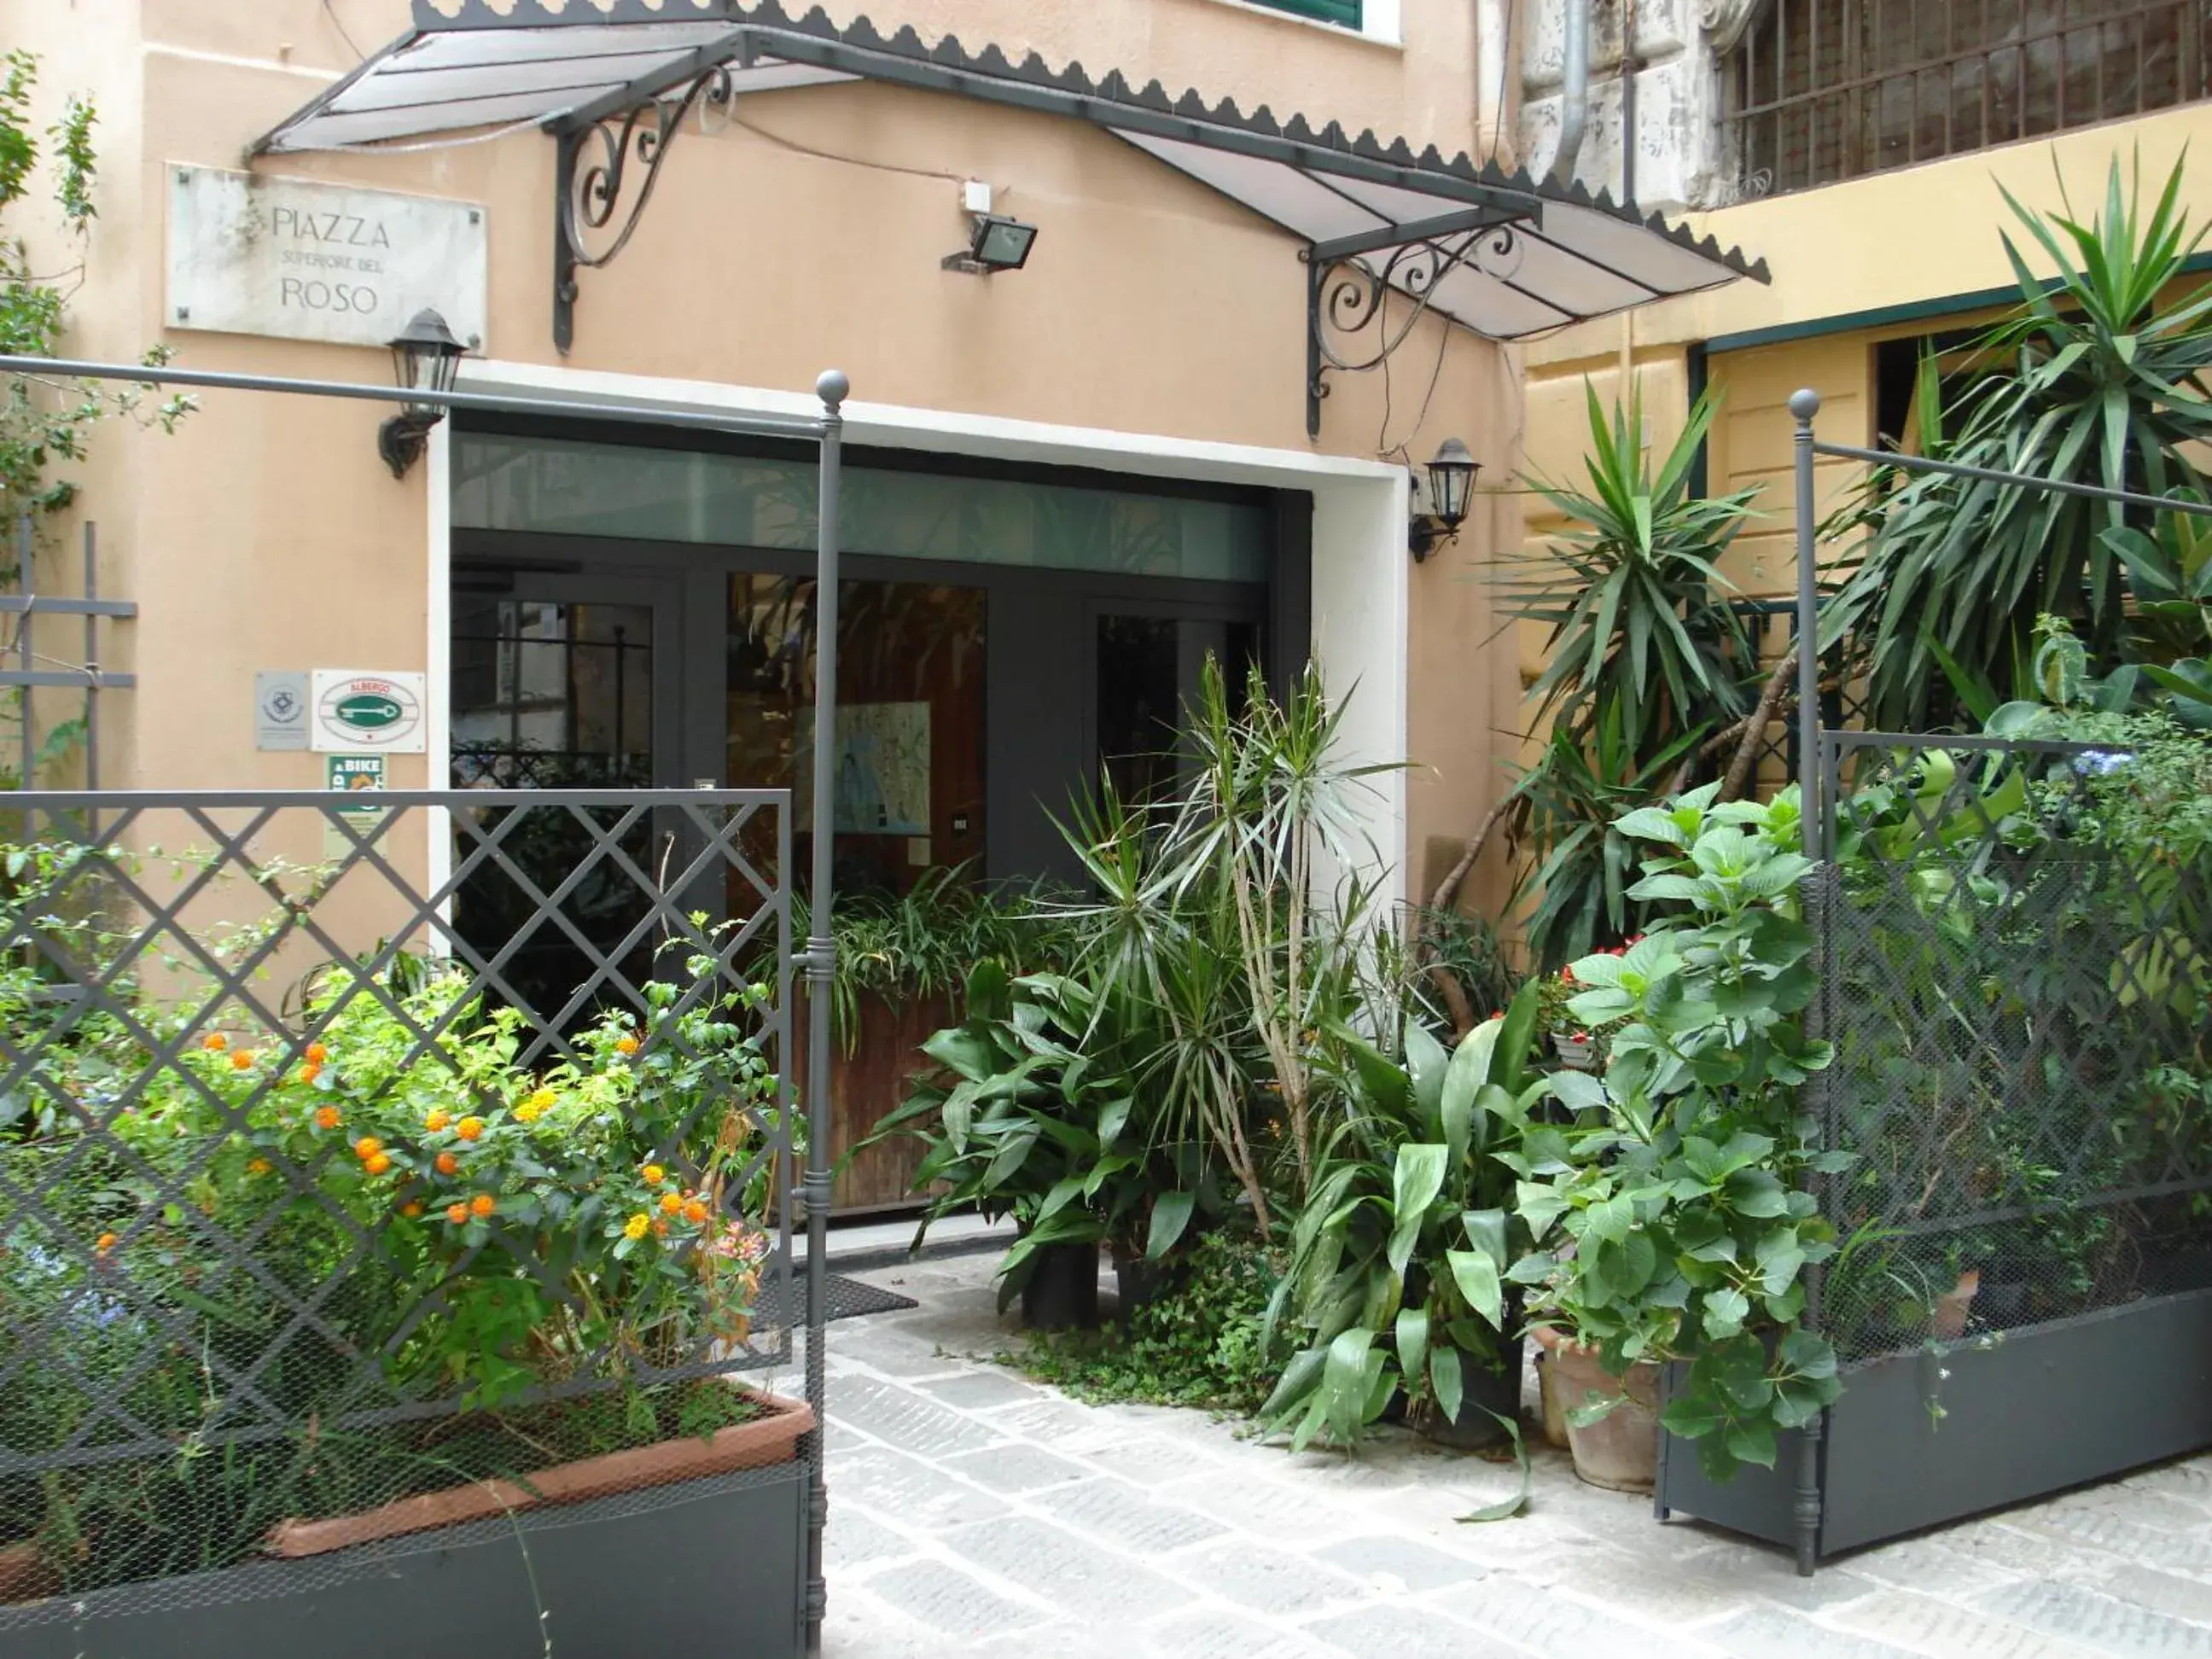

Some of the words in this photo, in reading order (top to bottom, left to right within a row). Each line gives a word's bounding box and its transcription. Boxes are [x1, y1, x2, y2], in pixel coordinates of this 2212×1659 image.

[271, 207, 390, 249] PIAZZA
[282, 249, 354, 271] SUPERIORE
[358, 259, 384, 274] DEL
[280, 277, 378, 315] ROSO
[350, 682, 390, 694] ALBERGO
[344, 760, 380, 772] BIKE
